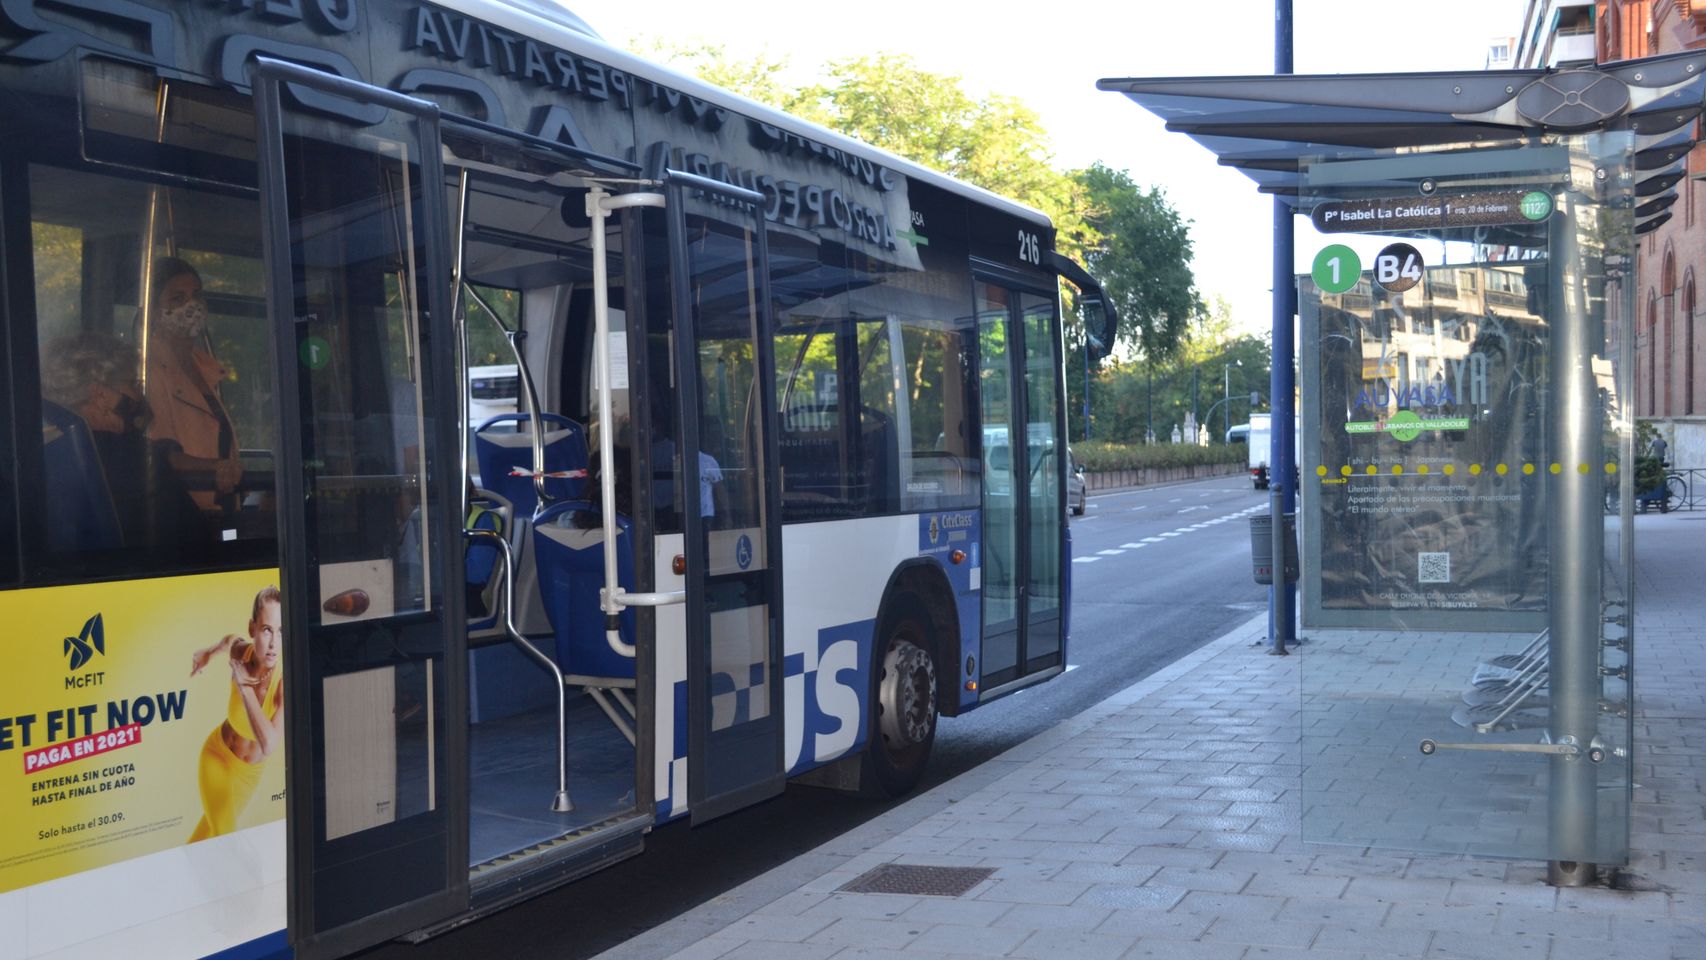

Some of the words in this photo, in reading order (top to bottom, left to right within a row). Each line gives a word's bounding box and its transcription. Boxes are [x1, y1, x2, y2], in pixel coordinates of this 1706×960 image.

[911, 209, 925, 228] ASA
[1341, 208, 1374, 221] Isabel
[1378, 208, 1392, 219] La
[1395, 204, 1441, 218] Católica
[1445, 205, 1451, 214] 1
[1018, 230, 1040, 265] 216
[1326, 256, 1340, 284] 1
[1378, 253, 1422, 283] B4
[1354, 385, 1457, 408] AUVASA
[65, 672, 105, 690] McFIT
[47, 704, 98, 742] FIT
[107, 689, 188, 731] NOW
[27, 746, 71, 771] PAGA
[74, 738, 94, 757] EN
[32, 775, 80, 792] ENTRENA
[82, 769, 100, 782] SIN
[102, 763, 135, 777] CUOTA
[32, 790, 66, 807] HASTA
[69, 785, 98, 800] FINAL
[100, 781, 112, 793] DE
[114, 775, 136, 790] AÑO
[38, 828, 59, 840] Solo
[61, 823, 86, 835] hasta
[87, 818, 96, 829] el
[98, 812, 126, 826] 30.09.
